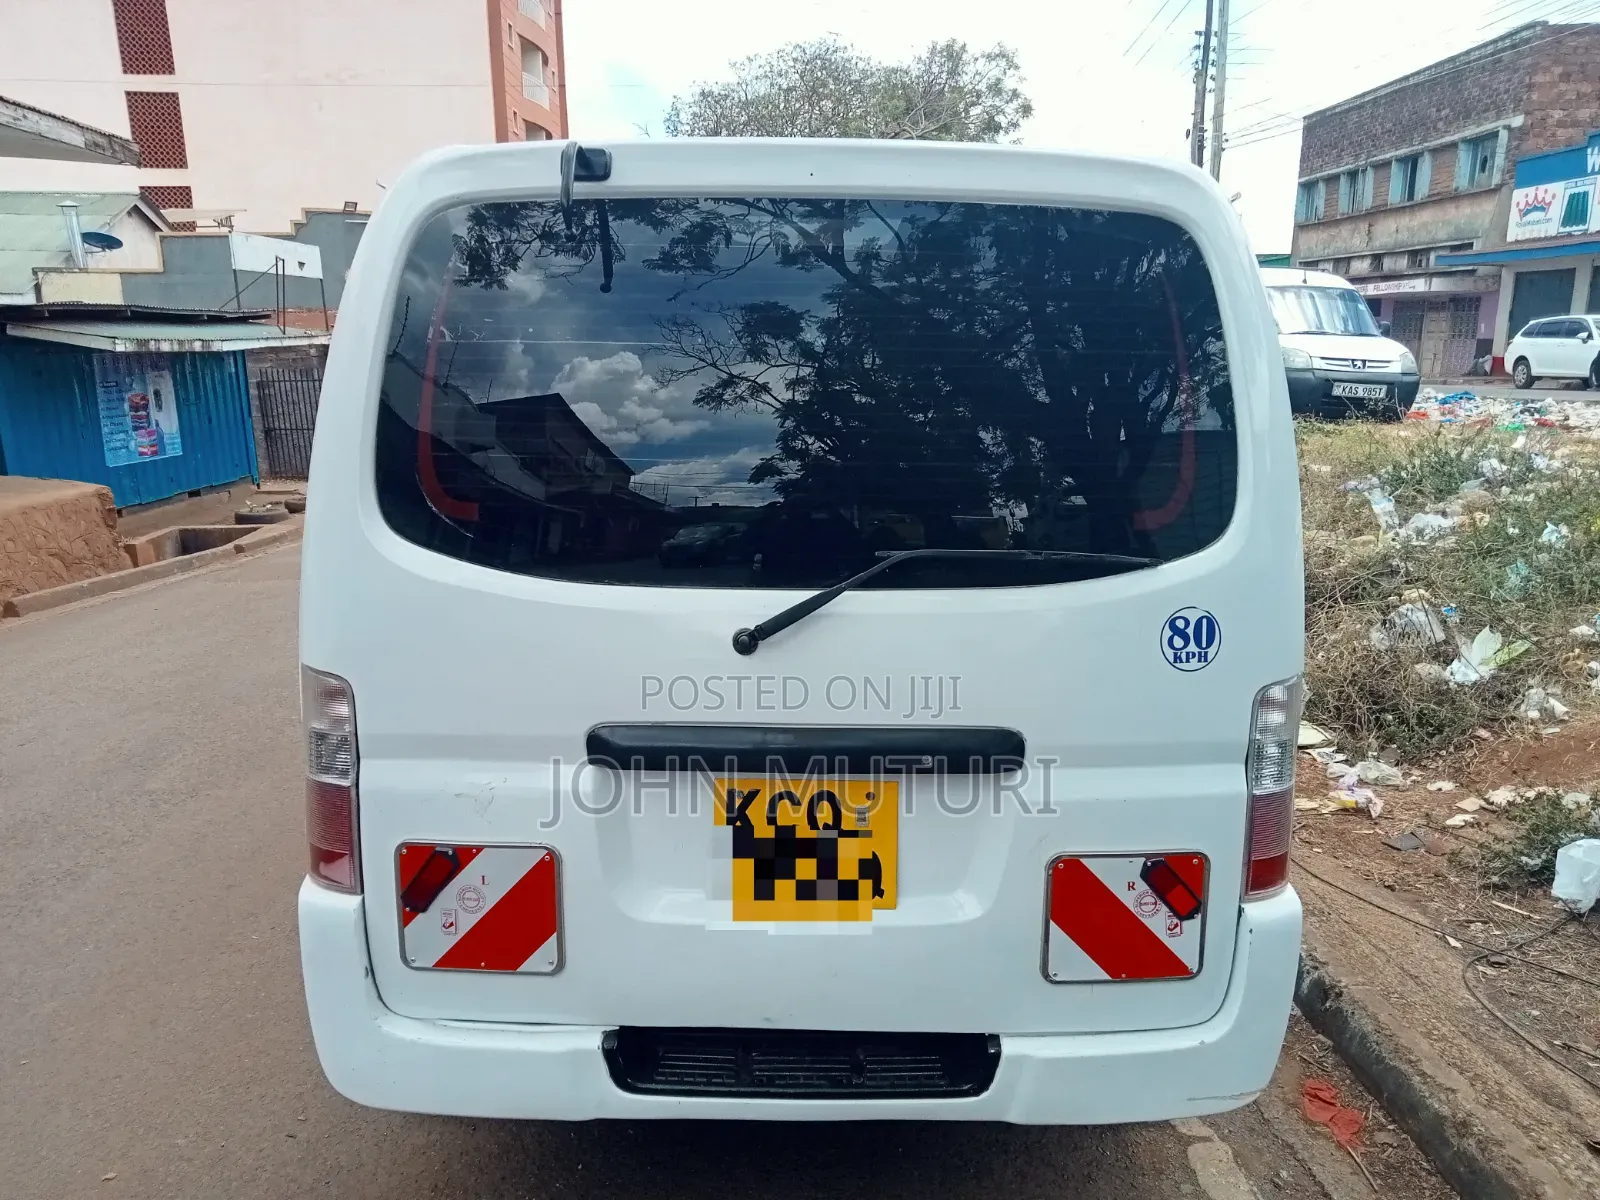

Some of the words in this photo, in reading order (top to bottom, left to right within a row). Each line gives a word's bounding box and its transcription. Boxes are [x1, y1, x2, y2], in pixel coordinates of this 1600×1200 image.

[1342, 385, 1359, 396] KAS
[1362, 387, 1384, 397] 985T
[1167, 615, 1216, 651] 80
[1172, 650, 1209, 664] KPH
[481, 875, 490, 886] L
[1127, 881, 1136, 891] R
